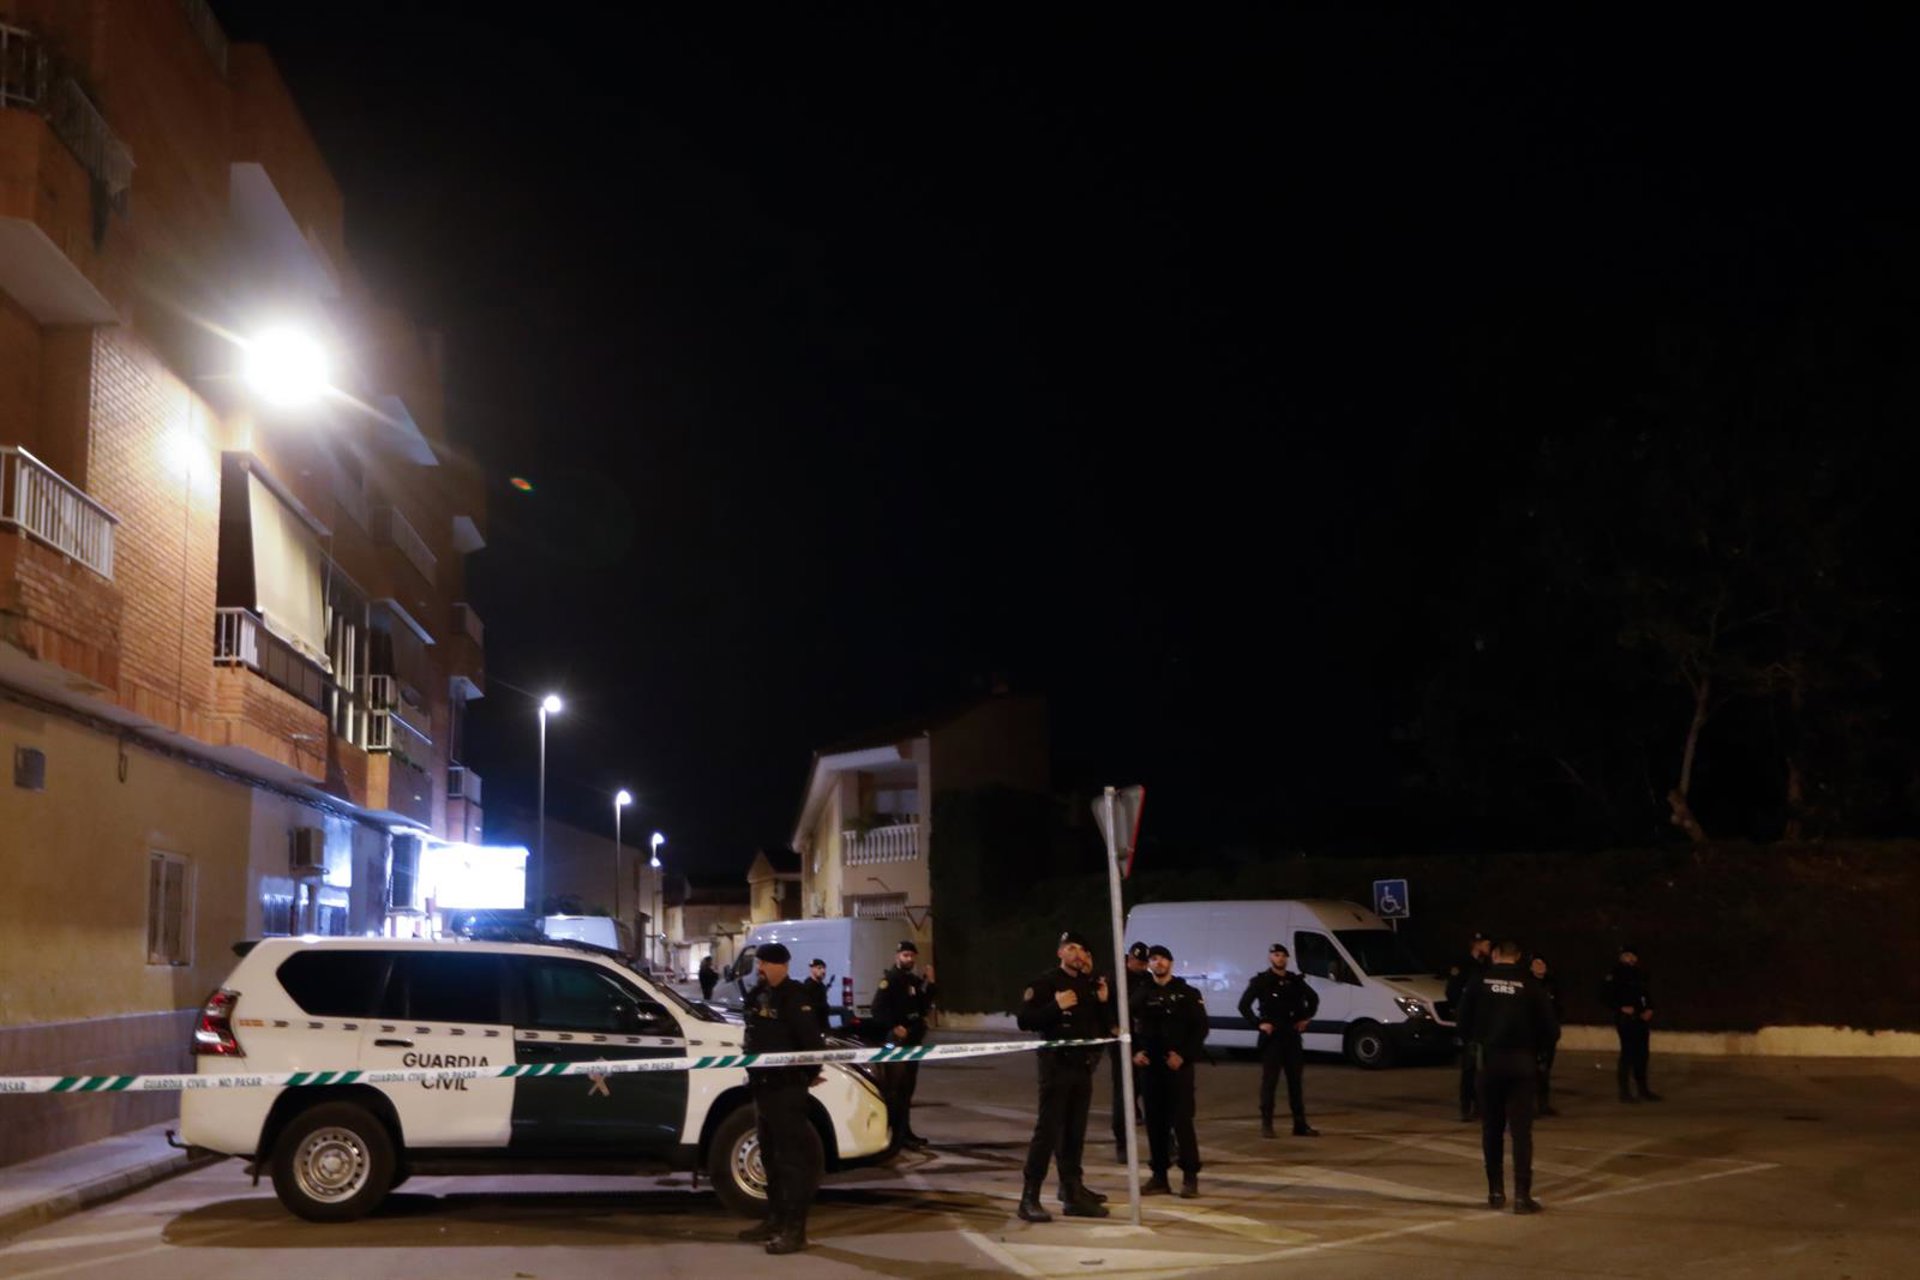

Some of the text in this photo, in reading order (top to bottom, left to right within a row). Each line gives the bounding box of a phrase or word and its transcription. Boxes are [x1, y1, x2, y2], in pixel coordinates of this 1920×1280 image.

[1491, 984, 1516, 995] GRS
[402, 1052, 489, 1068] GUARDIA
[143, 1079, 183, 1089] GUARDIA
[186, 1078, 208, 1088] CIVIL
[219, 1077, 232, 1087] NO
[234, 1076, 262, 1087] PASAR
[421, 1078, 468, 1091] CIVIL
